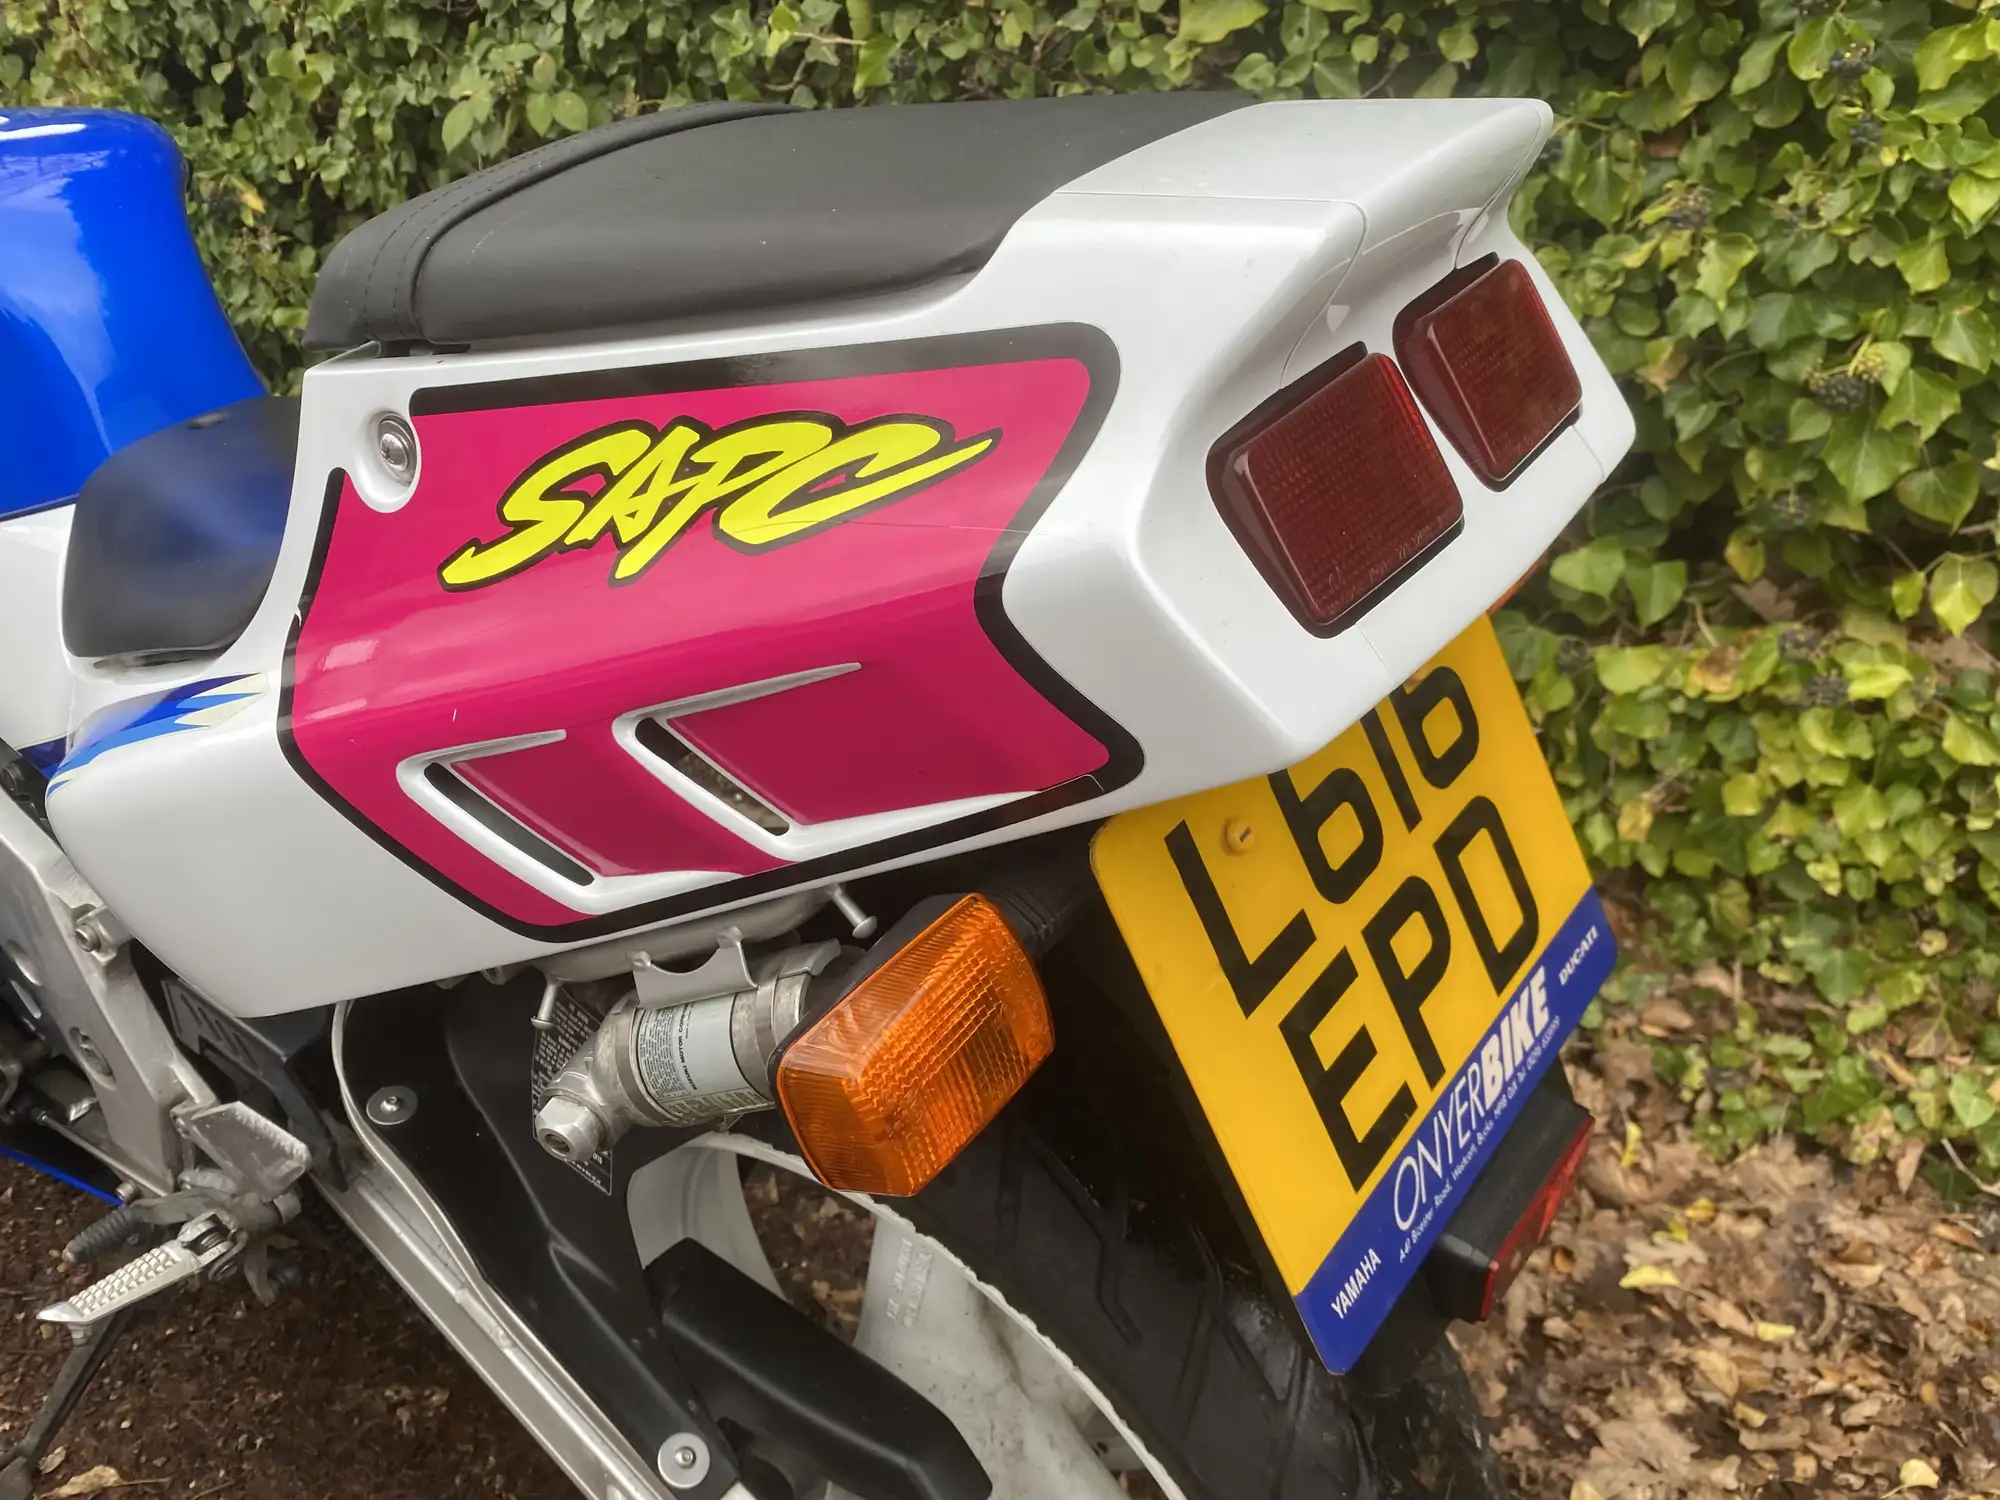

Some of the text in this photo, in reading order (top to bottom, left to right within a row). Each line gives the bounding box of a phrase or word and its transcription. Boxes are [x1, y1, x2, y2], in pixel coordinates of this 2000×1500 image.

[438, 412, 1002, 591] SAPC
[1164, 666, 1479, 1019] L616
[1278, 796, 1539, 1193] EPD
[1559, 925, 1598, 986] DUCATI
[1331, 1248, 1381, 1319] YAMAHA
